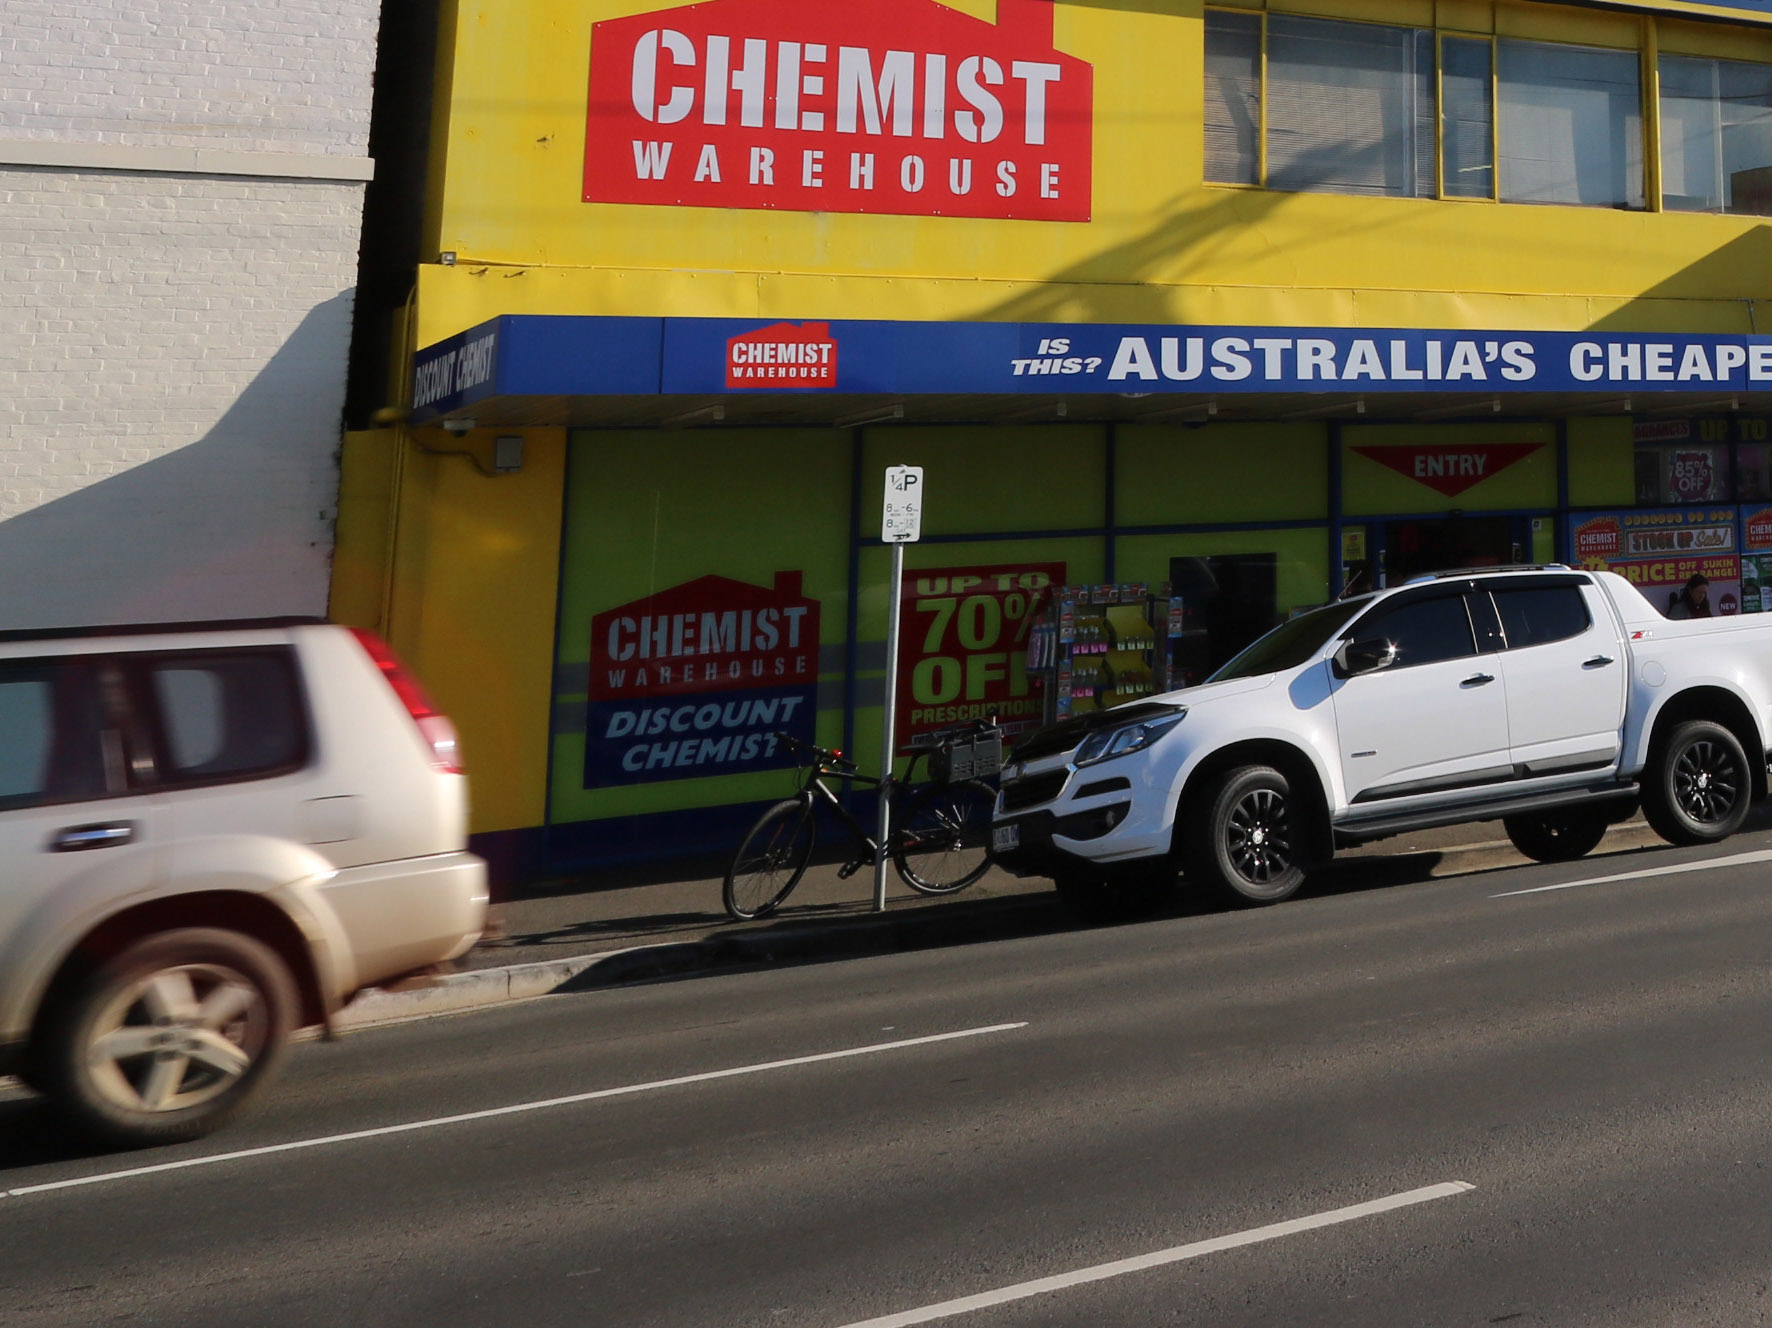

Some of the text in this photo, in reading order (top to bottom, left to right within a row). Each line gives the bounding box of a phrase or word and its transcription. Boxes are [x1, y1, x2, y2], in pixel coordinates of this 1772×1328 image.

[630, 28, 1062, 146] CHEMIST
[631, 139, 1061, 200] WAREHOUSE
[732, 342, 832, 364] CHEMIST
[1037, 338, 1070, 355] IS
[1010, 357, 1102, 375] THIS?
[1107, 336, 1537, 381] AUSTRALIA'S
[413, 332, 495, 410] DISCOUNT CHEMIST
[732, 366, 828, 378] WAREHOUSE
[1700, 420, 1728, 441] UP
[1739, 418, 1767, 440] TO
[1414, 454, 1487, 477] ENTRY
[1675, 460, 1708, 478] 85%
[1679, 477, 1704, 491] OFF
[1580, 533, 1616, 545] CHEMIST
[1678, 561, 1698, 571] OFF
[1703, 559, 1734, 569] SUKIN
[916, 572, 1050, 596] UP TO
[1720, 602, 1736, 611] NEW
[607, 606, 808, 662] CHEMIST
[608, 655, 807, 689] WAREHOUSE
[605, 696, 804, 739] DISCOUNT
[622, 731, 788, 772] CHEMIST
